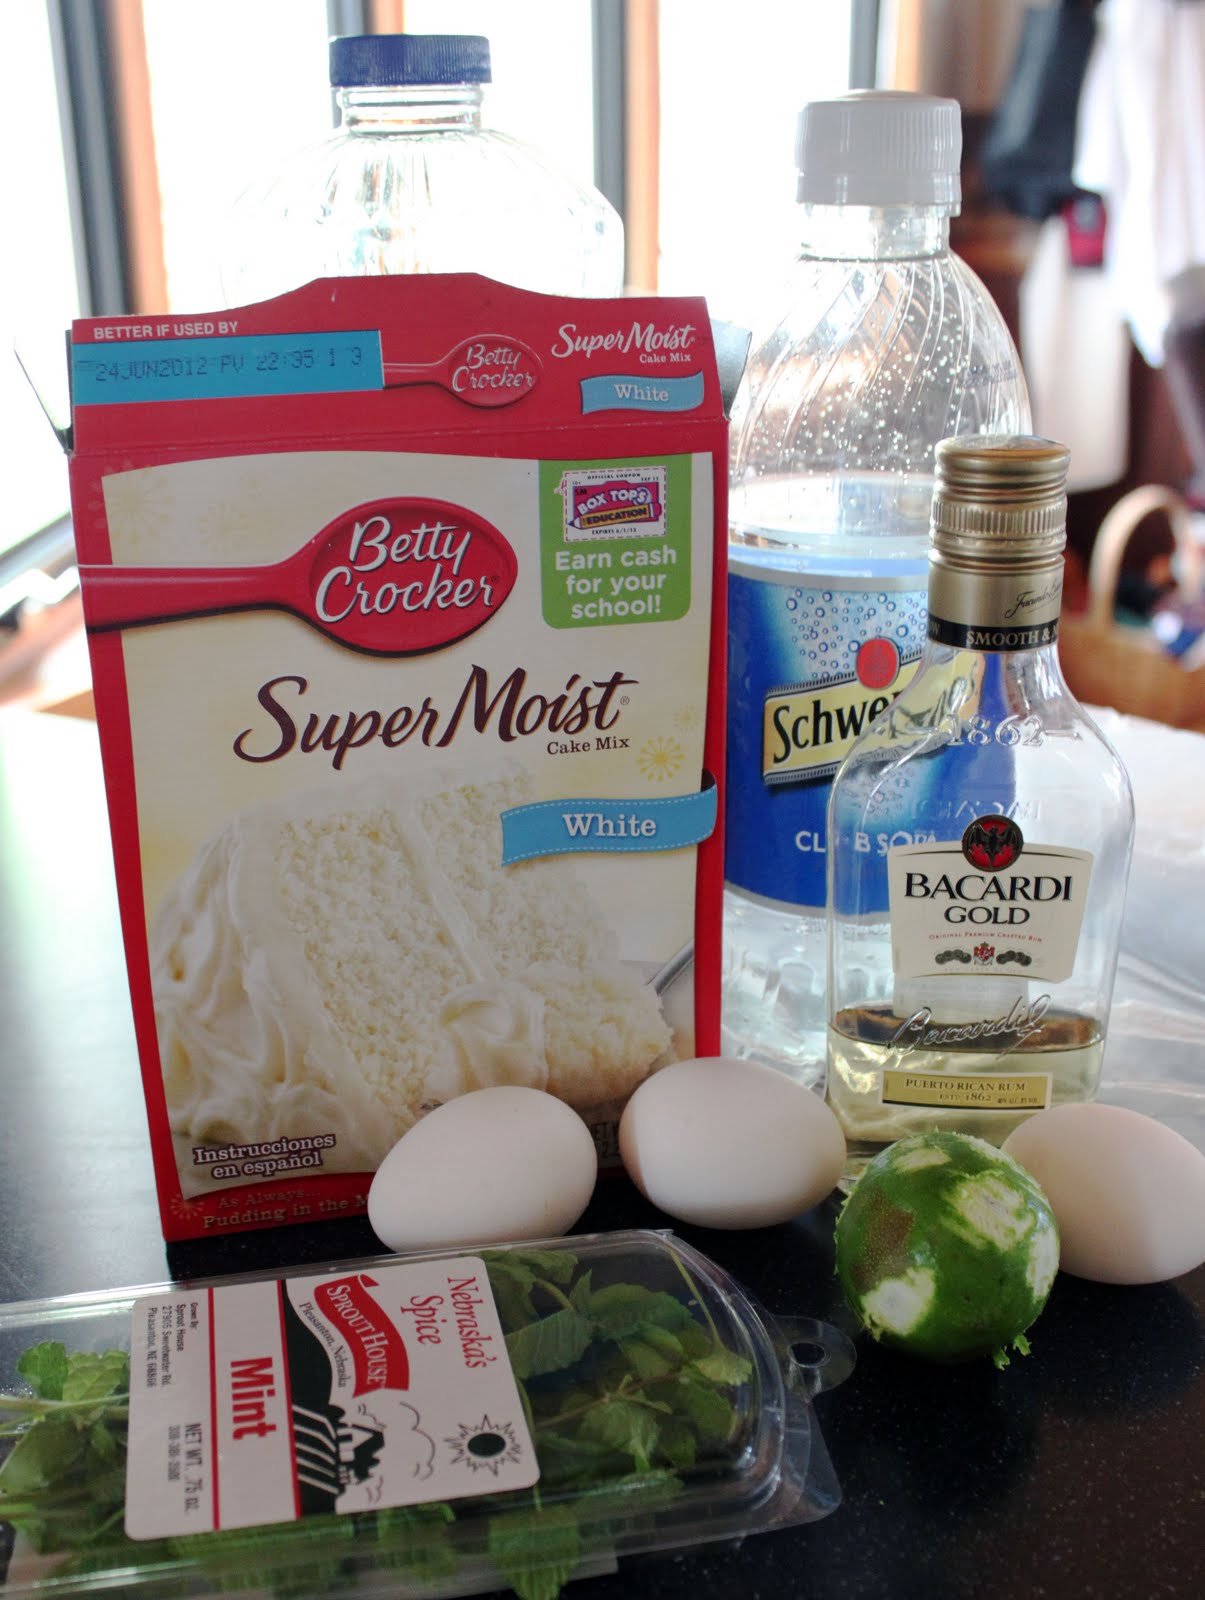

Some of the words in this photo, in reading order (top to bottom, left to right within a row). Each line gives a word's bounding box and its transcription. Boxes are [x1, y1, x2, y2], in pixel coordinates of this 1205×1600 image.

[94, 326, 152, 340] BETTER
[157, 324, 170, 337] IF
[174, 322, 214, 336] USED
[218, 321, 238, 333] BY
[466, 343, 521, 371] Betty
[639, 353, 667, 364] Cake
[669, 352, 692, 363] Mix
[452, 366, 534, 393] Crocker
[613, 384, 669, 402] White
[577, 493, 608, 515] BOX
[609, 489, 648, 503] TOPS
[586, 507, 647, 525] EDUCATION
[349, 516, 472, 576] Betty
[555, 551, 612, 571] Earn
[620, 544, 677, 567] cash
[315, 563, 494, 623] Crocker
[566, 574, 602, 596] for
[610, 574, 667, 596] your
[571, 594, 661, 619] school!
[967, 629, 1040, 646] SMOOTH
[1042, 627, 1051, 642] &
[547, 738, 591, 756] Cake
[595, 736, 630, 751] Mix
[562, 812, 657, 838] White
[795, 830, 870, 853] CLB
[904, 872, 1073, 901] BACARDI
[943, 905, 1031, 925] GOLD
[906, 1078, 954, 1090] PUERTO
[957, 1080, 995, 1091] RICAN
[998, 1082, 1025, 1091] RUM
[965, 1092, 992, 1102] 1862
[194, 1134, 335, 1164] Instrucciones
[211, 1164, 239, 1179] en
[243, 1151, 323, 1177] español
[203, 1207, 287, 1229] Pudding
[293, 1203, 311, 1216] in
[319, 1199, 348, 1212] the
[218, 1198, 238, 1209] As
[175, 1303, 186, 1328] Sprout
[400, 1295, 447, 1345] Spice
[447, 1276, 497, 1369] Nebraska's
[176, 1328, 186, 1352] House
[299, 1301, 336, 1348] Pleasanton,
[333, 1345, 352, 1389] Nebraska
[146, 1350, 157, 1362] NE
[231, 1357, 277, 1440] Mint
[185, 1422, 202, 1444] NET
